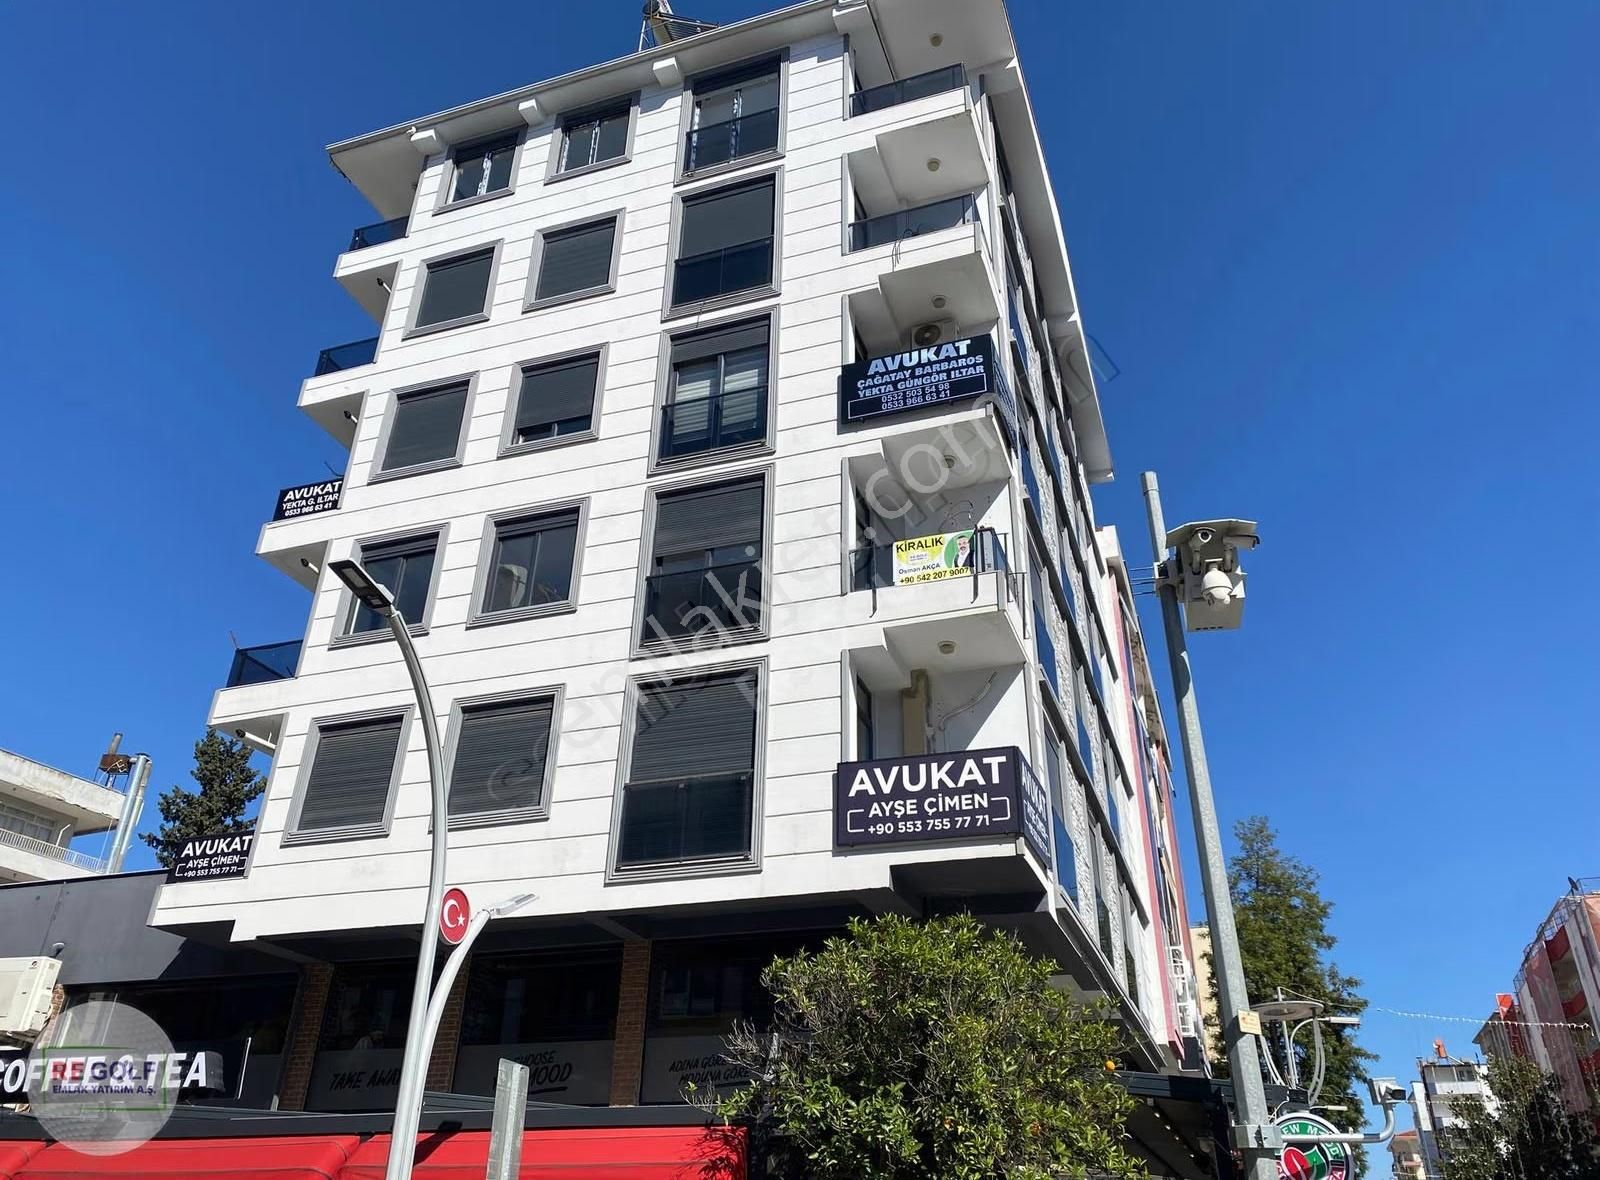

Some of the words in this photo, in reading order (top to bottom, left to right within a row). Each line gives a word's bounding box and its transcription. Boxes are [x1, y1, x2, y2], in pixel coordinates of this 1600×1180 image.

[867, 339, 972, 375] AVUKAT
[857, 369, 912, 388] ÇAĞATAY
[915, 355, 984, 375] BARBAROS
[857, 385, 893, 398] YEKTA
[897, 373, 947, 389] GÜNGÖR
[951, 366, 985, 378] ILTAR
[881, 391, 904, 403] 0532
[906, 388, 922, 398] 503
[925, 385, 937, 394] 54
[938, 383, 950, 391] 98
[881, 400, 904, 411] 0533
[906, 395, 923, 405] 966
[925, 392, 937, 401] 63
[939, 390, 951, 398] 41
[284, 481, 342, 501] AVUKAT
[282, 500, 306, 510] YEKTA
[284, 508, 301, 517] 0533
[896, 536, 944, 553] KİRALIK
[899, 566, 921, 575] Osman
[922, 562, 940, 572] AKÇA
[900, 576, 914, 584] +90
[917, 573, 931, 582] 542
[933, 570, 948, 580] 207
[950, 567, 970, 577] 9007
[848, 756, 1006, 797] AVUKAT
[868, 799, 918, 819] AYŞE
[924, 793, 989, 816] ÇİMEN
[868, 822, 894, 835] +90
[898, 820, 923, 833] 553
[927, 818, 950, 830] 755
[955, 816, 971, 828] 77
[975, 815, 990, 827] 71
[181, 835, 253, 858] AVUKAT
[186, 858, 210, 869] AYŞE
[211, 855, 240, 868] ÇİMEN
[197, 869, 208, 877] 553
[209, 867, 220, 875] 755
[145, 1051, 208, 1089] TEA
[329, 1071, 366, 1091] TAKE
[367, 1067, 402, 1088] AWA
